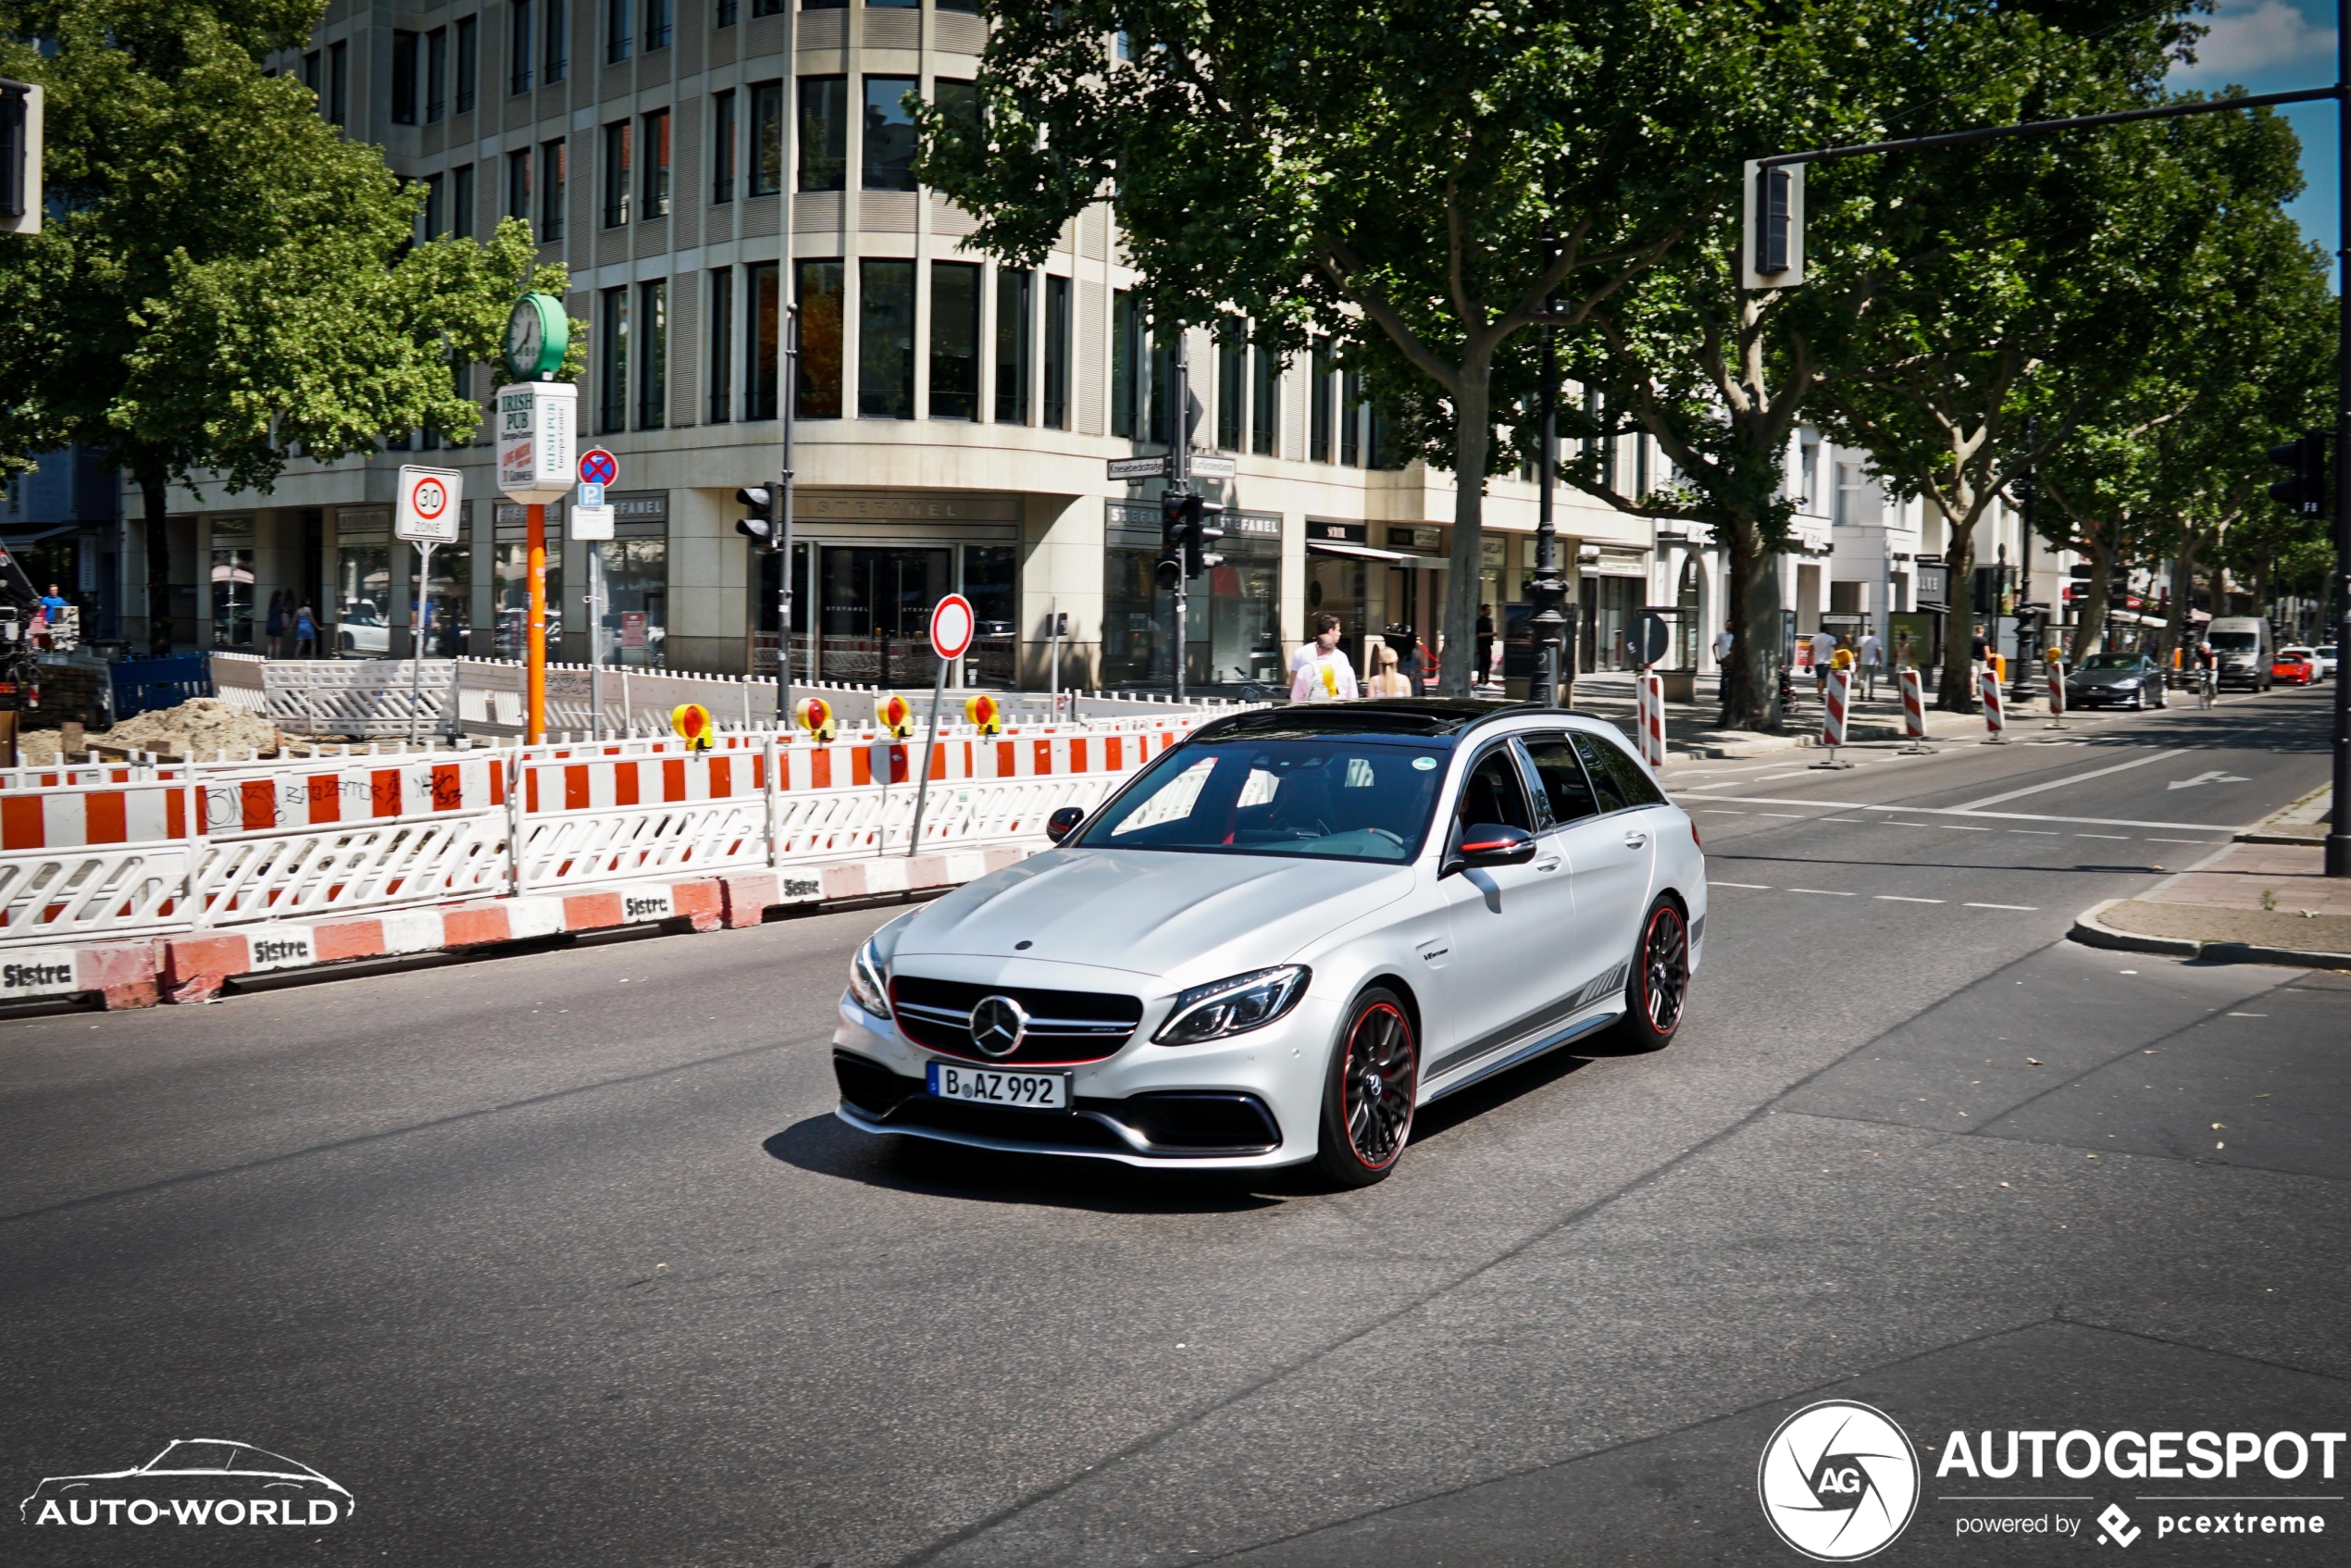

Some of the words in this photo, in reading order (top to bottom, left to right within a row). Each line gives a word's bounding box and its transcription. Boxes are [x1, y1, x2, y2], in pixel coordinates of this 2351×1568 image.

[502, 393, 533, 412] IRISH
[506, 412, 528, 429] PUB
[547, 404, 555, 429] PUB
[547, 434, 555, 472] IRISH
[419, 489, 441, 507] 30
[817, 501, 956, 516] STEFANEL
[414, 521, 441, 534] ZONE
[1220, 516, 1278, 532] STEFANEL
[255, 940, 308, 964] Sistra
[4, 964, 71, 988] Sistra
[946, 1069, 959, 1094] B
[975, 1074, 1002, 1100] AZ
[1008, 1076, 1053, 1103] 992
